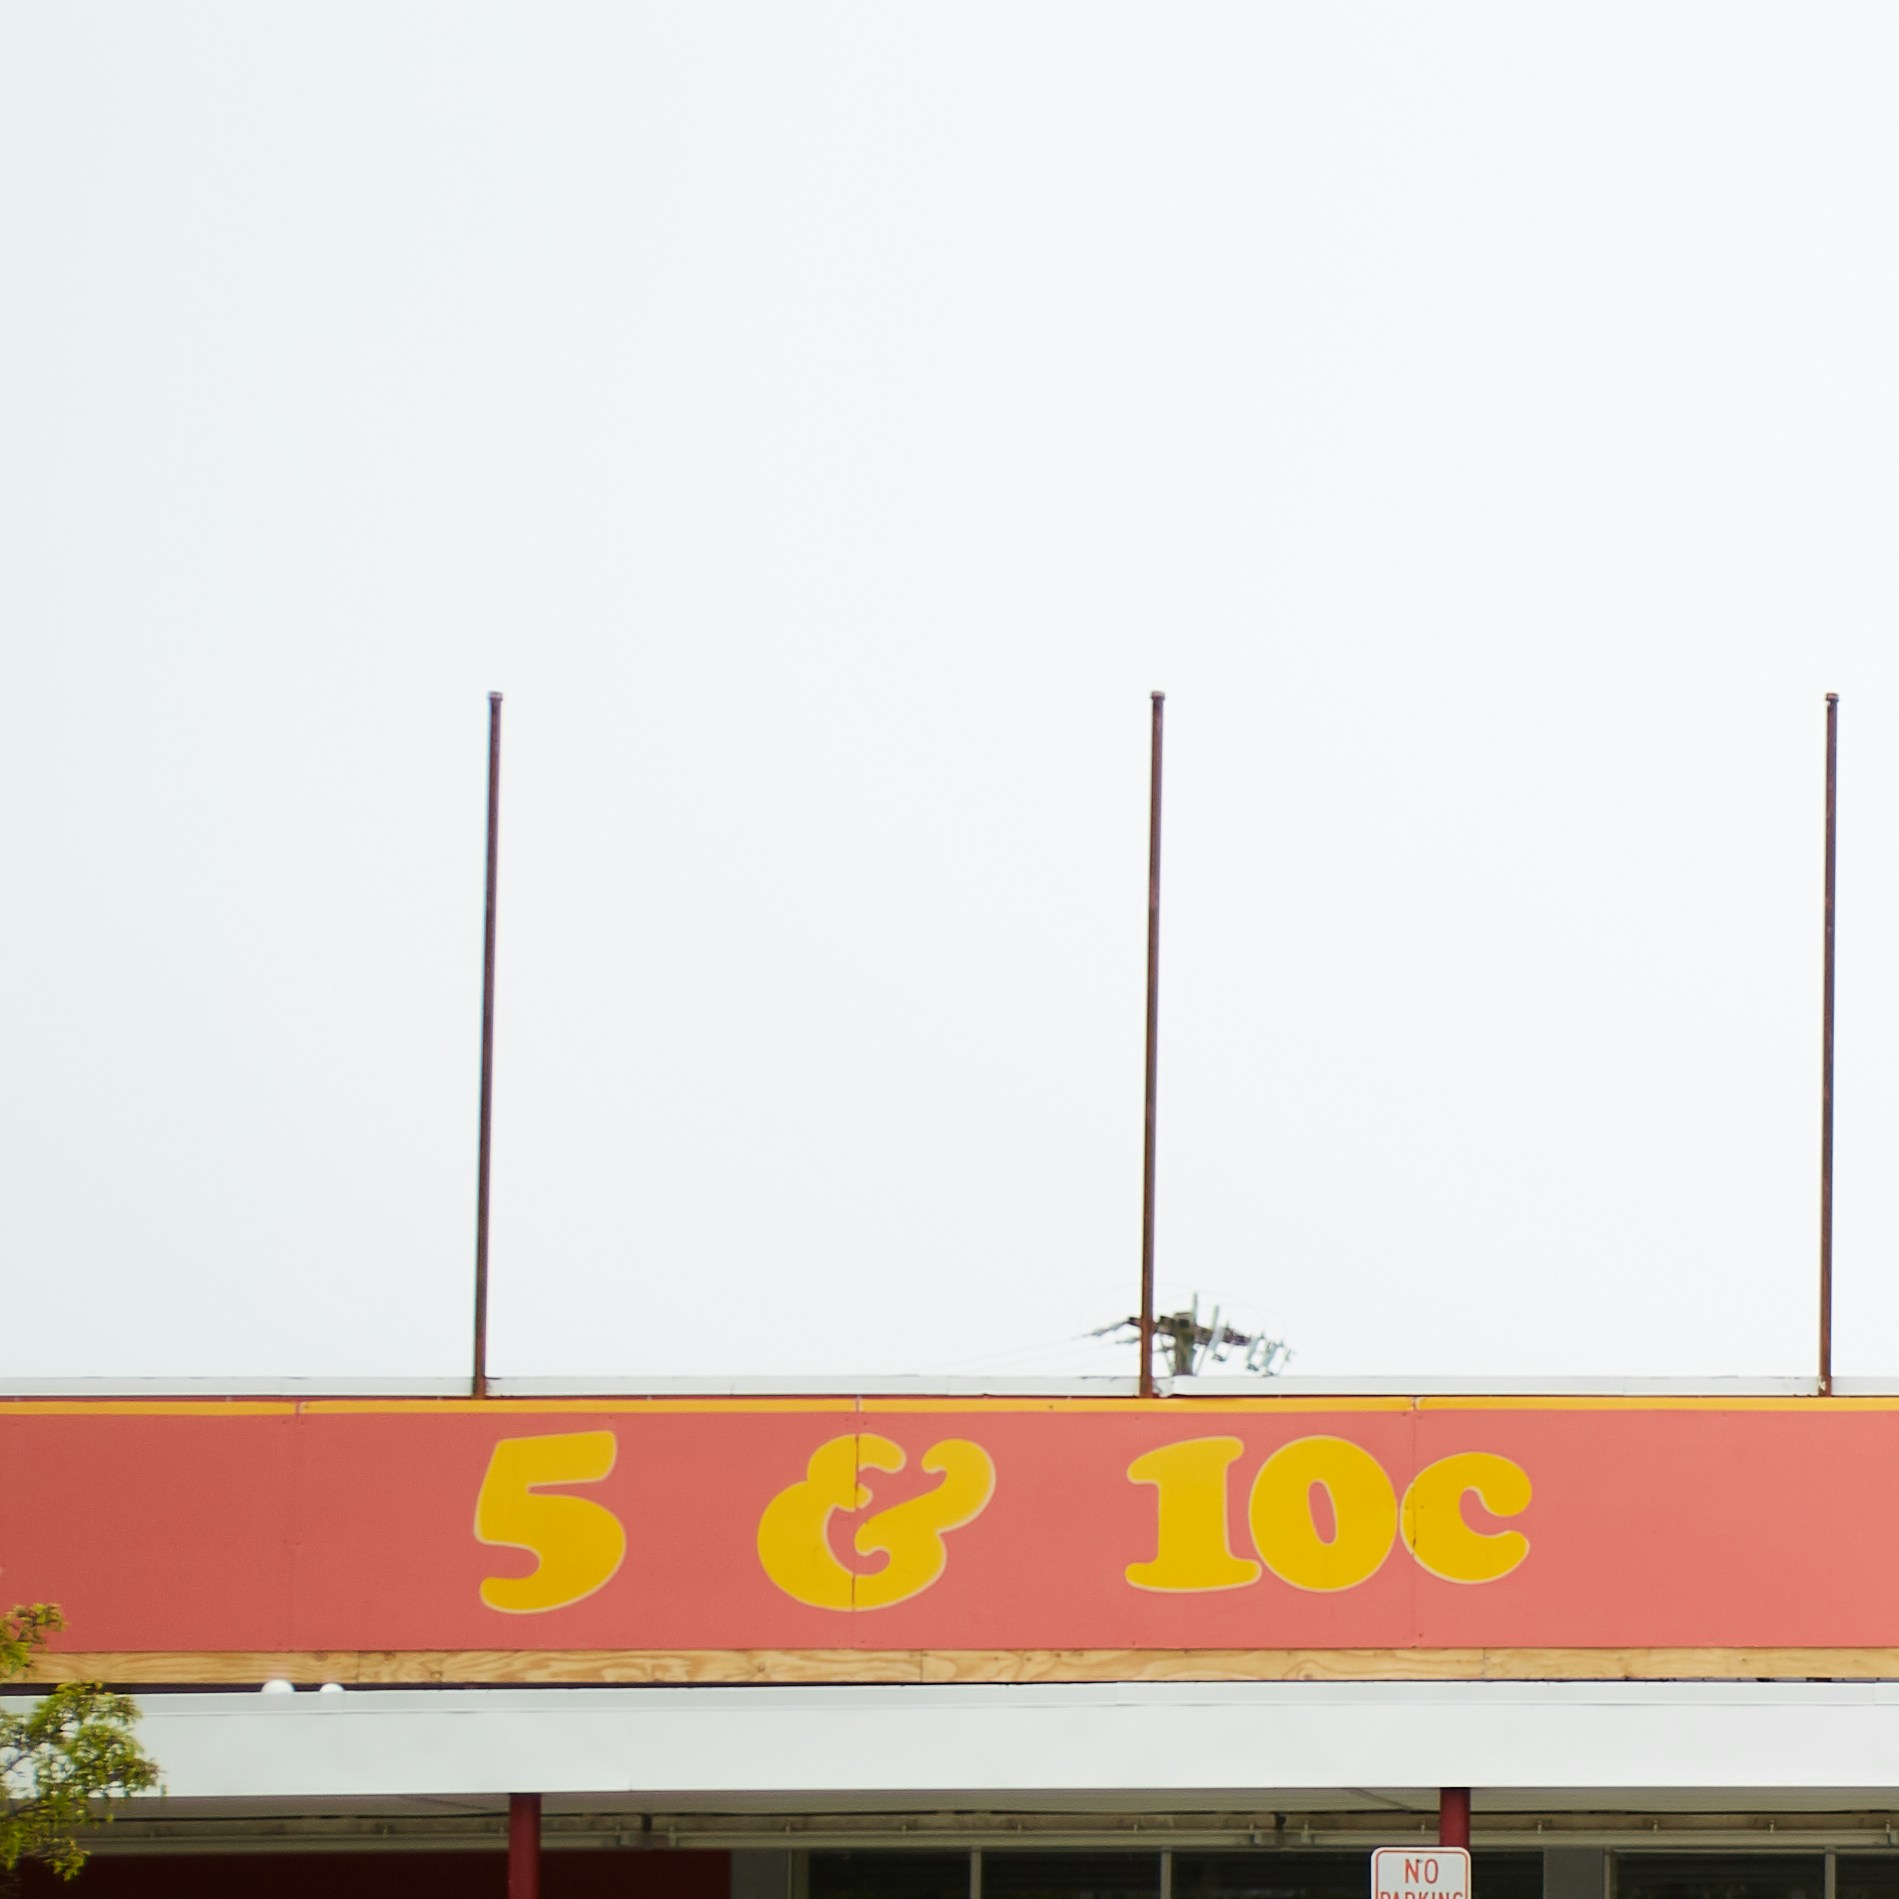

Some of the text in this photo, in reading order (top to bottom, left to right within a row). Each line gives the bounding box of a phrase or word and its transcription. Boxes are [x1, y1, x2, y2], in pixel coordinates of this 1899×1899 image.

[473, 1430, 627, 1615] 5
[757, 1432, 996, 1612] &
[1404, 1858, 1439, 1884] NO
